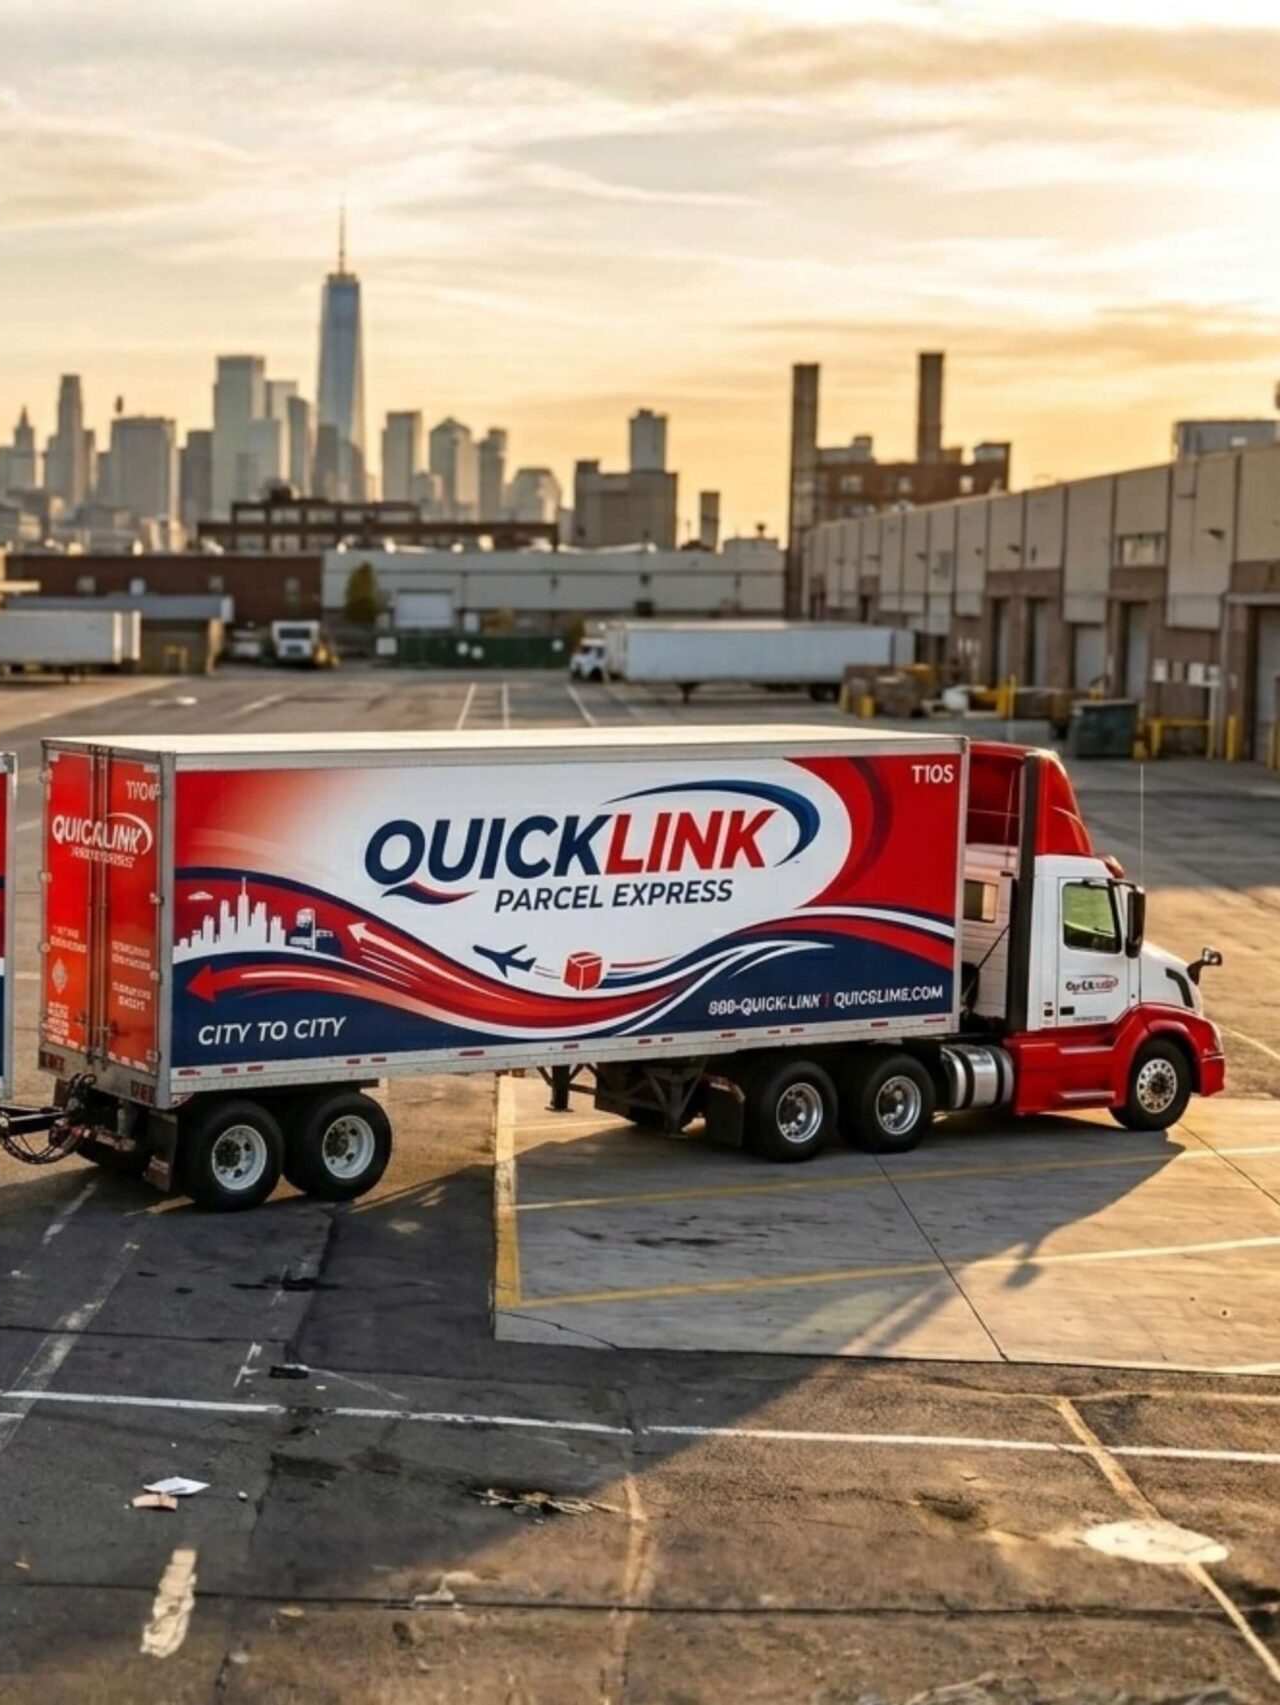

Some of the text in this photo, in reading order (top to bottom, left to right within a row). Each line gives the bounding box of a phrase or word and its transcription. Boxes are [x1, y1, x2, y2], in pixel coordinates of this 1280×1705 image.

[364, 808, 778, 905] QUICKLINK
[494, 879, 733, 913] PARCEL EXPRESS
[198, 1016, 346, 1045] CITY TO CITY
